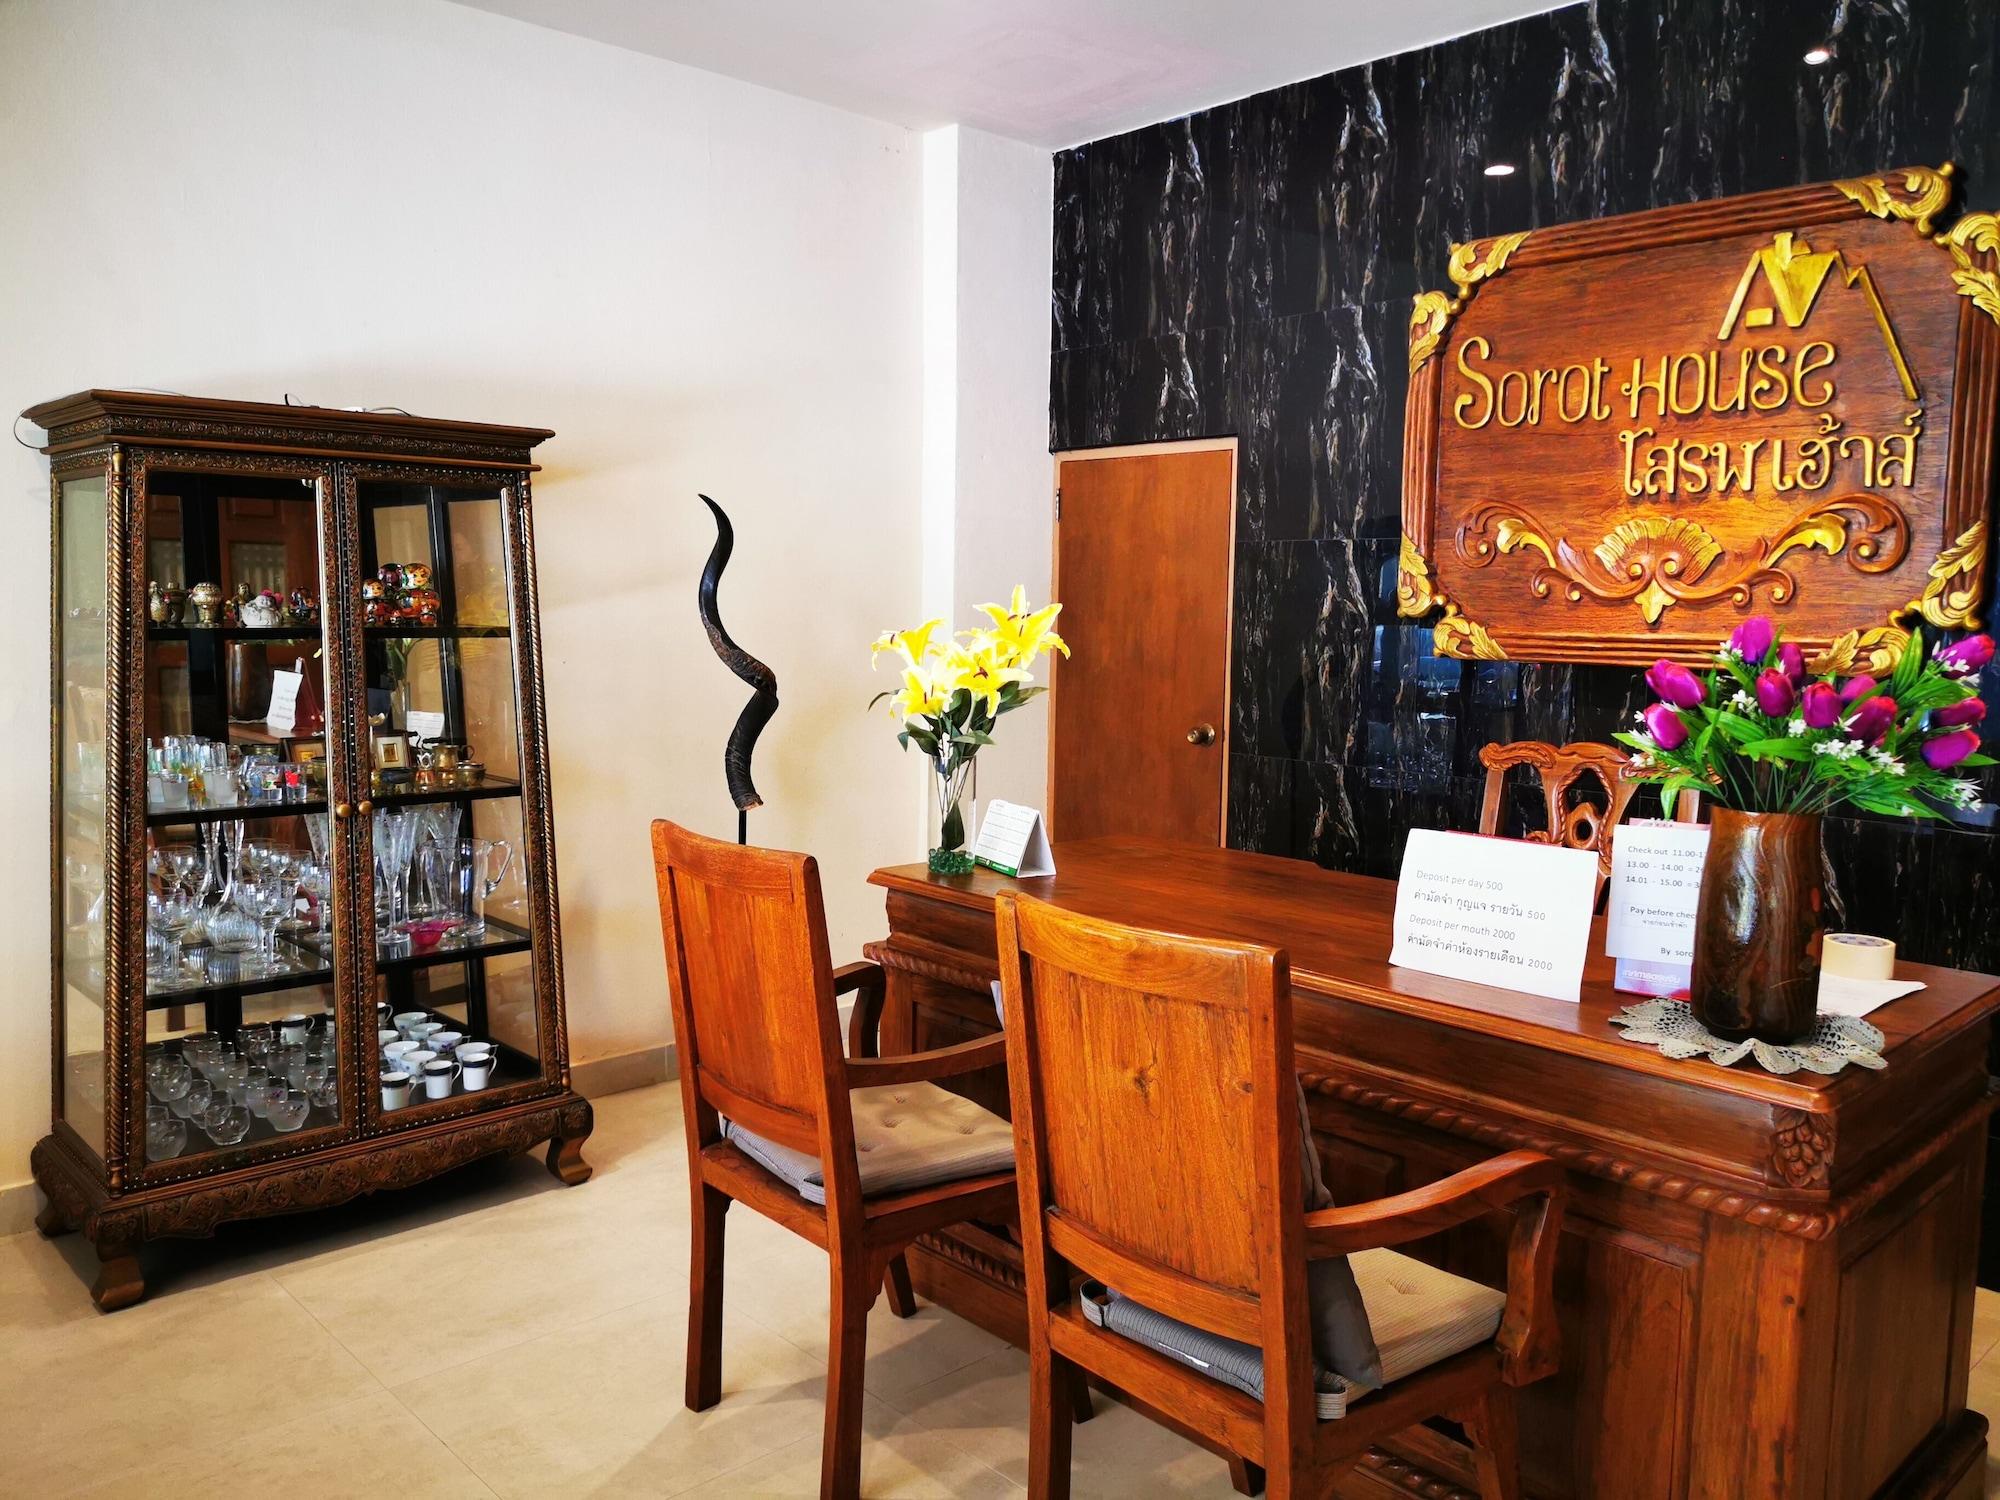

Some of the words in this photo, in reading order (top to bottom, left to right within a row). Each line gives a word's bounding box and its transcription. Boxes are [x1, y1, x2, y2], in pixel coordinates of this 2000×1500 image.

[1453, 335, 1612, 430] Sorot
[1627, 845, 1652, 855] Check
[1653, 848, 1669, 857] out
[1672, 849, 1704, 859] 11.00-1
[1626, 860, 1650, 870] 13.00
[1661, 863, 1684, 873] 14.00
[1416, 869, 1450, 884] Deposit
[1451, 876, 1466, 885] per
[1467, 878, 1485, 889] day
[1486, 880, 1504, 892] 500
[1625, 875, 1648, 885] 14.01
[1660, 878, 1684, 888] 15.00
[1414, 888, 1453, 904] ค่ามัดจำ
[1456, 898, 1487, 912] กุญแจ
[1490, 903, 1523, 918] รายวัน
[1527, 910, 1546, 921] 500
[1630, 906, 1645, 918] Pay
[1647, 908, 1675, 918] before
[1676, 911, 1697, 920] chec
[1409, 913, 1443, 928] Deposit
[1444, 920, 1460, 931] per
[1461, 924, 1491, 936] mouth
[1492, 928, 1516, 941] 2000
[1660, 947, 1671, 957] By
[1675, 949, 1695, 959] soro
[1527, 958, 1553, 972] 2000
